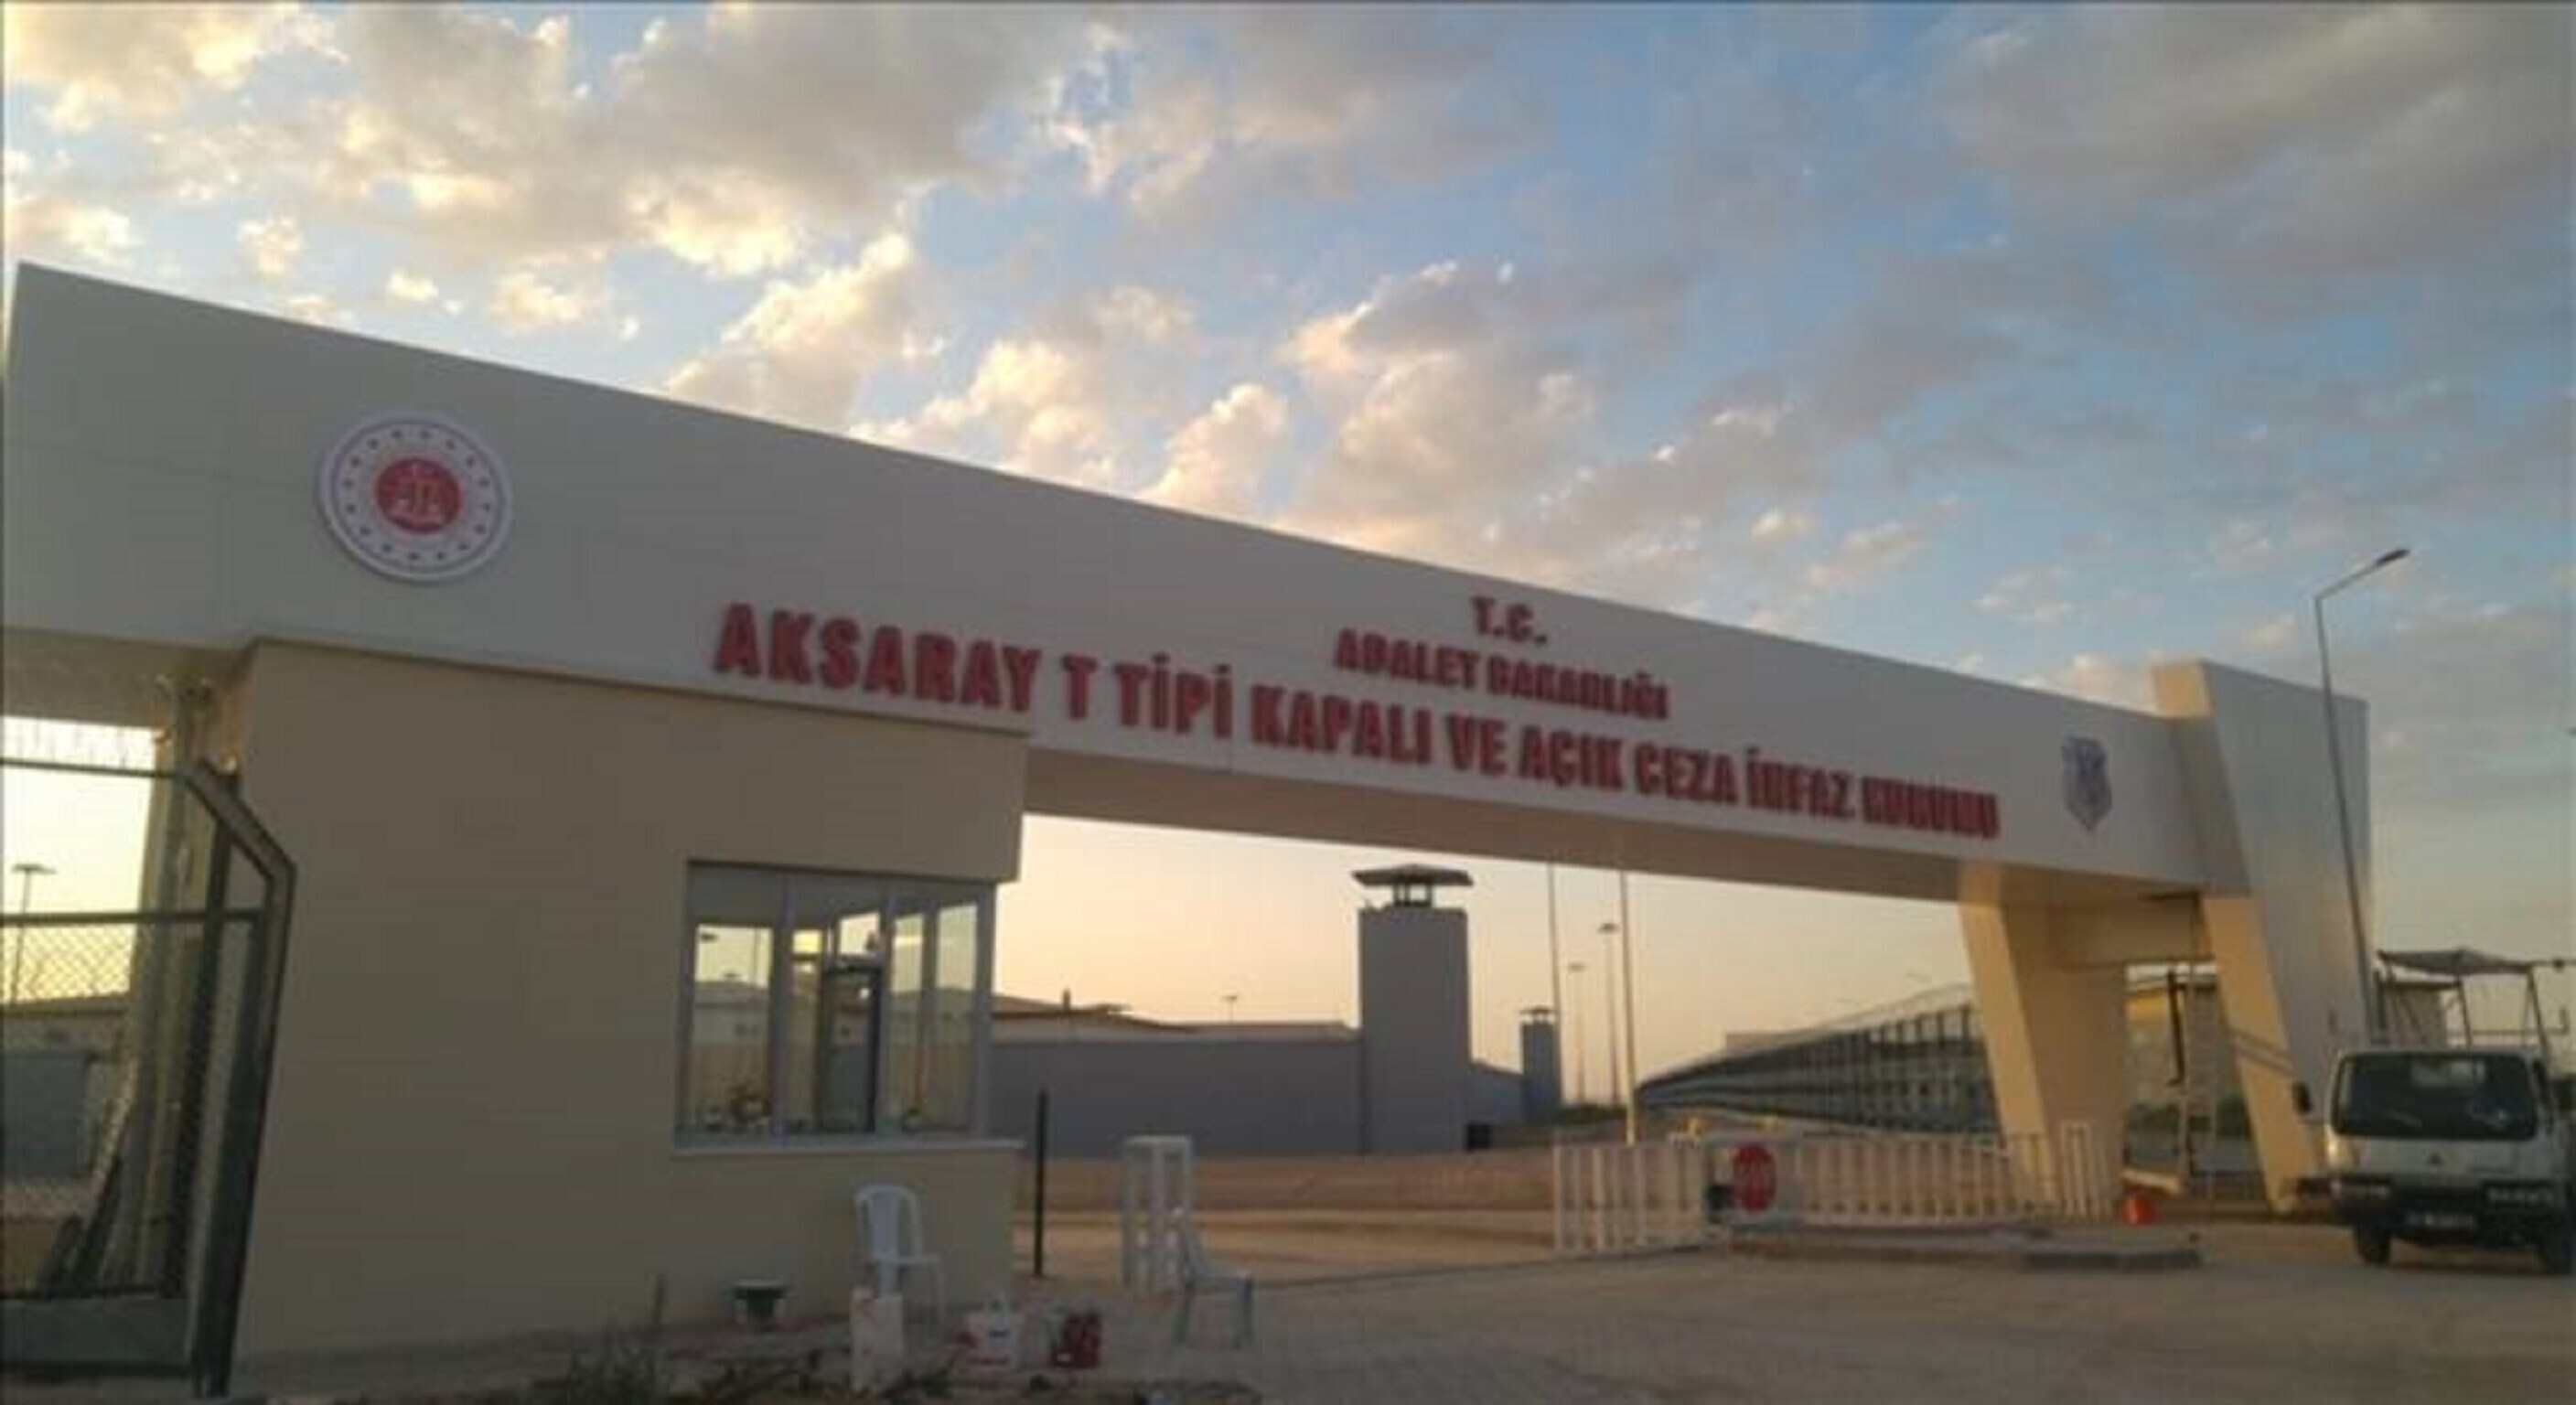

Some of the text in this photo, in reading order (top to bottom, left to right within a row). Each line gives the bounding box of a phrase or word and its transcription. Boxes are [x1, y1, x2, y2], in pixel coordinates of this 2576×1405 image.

[1473, 595, 1548, 644] T.C.
[1335, 628, 1481, 691] ADALET
[714, 600, 1042, 713] AKSARAY
[1061, 653, 1099, 721] T
[1113, 651, 1233, 740] TİPİ
[1250, 683, 1433, 766] KAPALI
[1444, 713, 1508, 776] VE
[1517, 724, 1626, 789] AÇIK
[1633, 740, 1739, 805] CEZA
